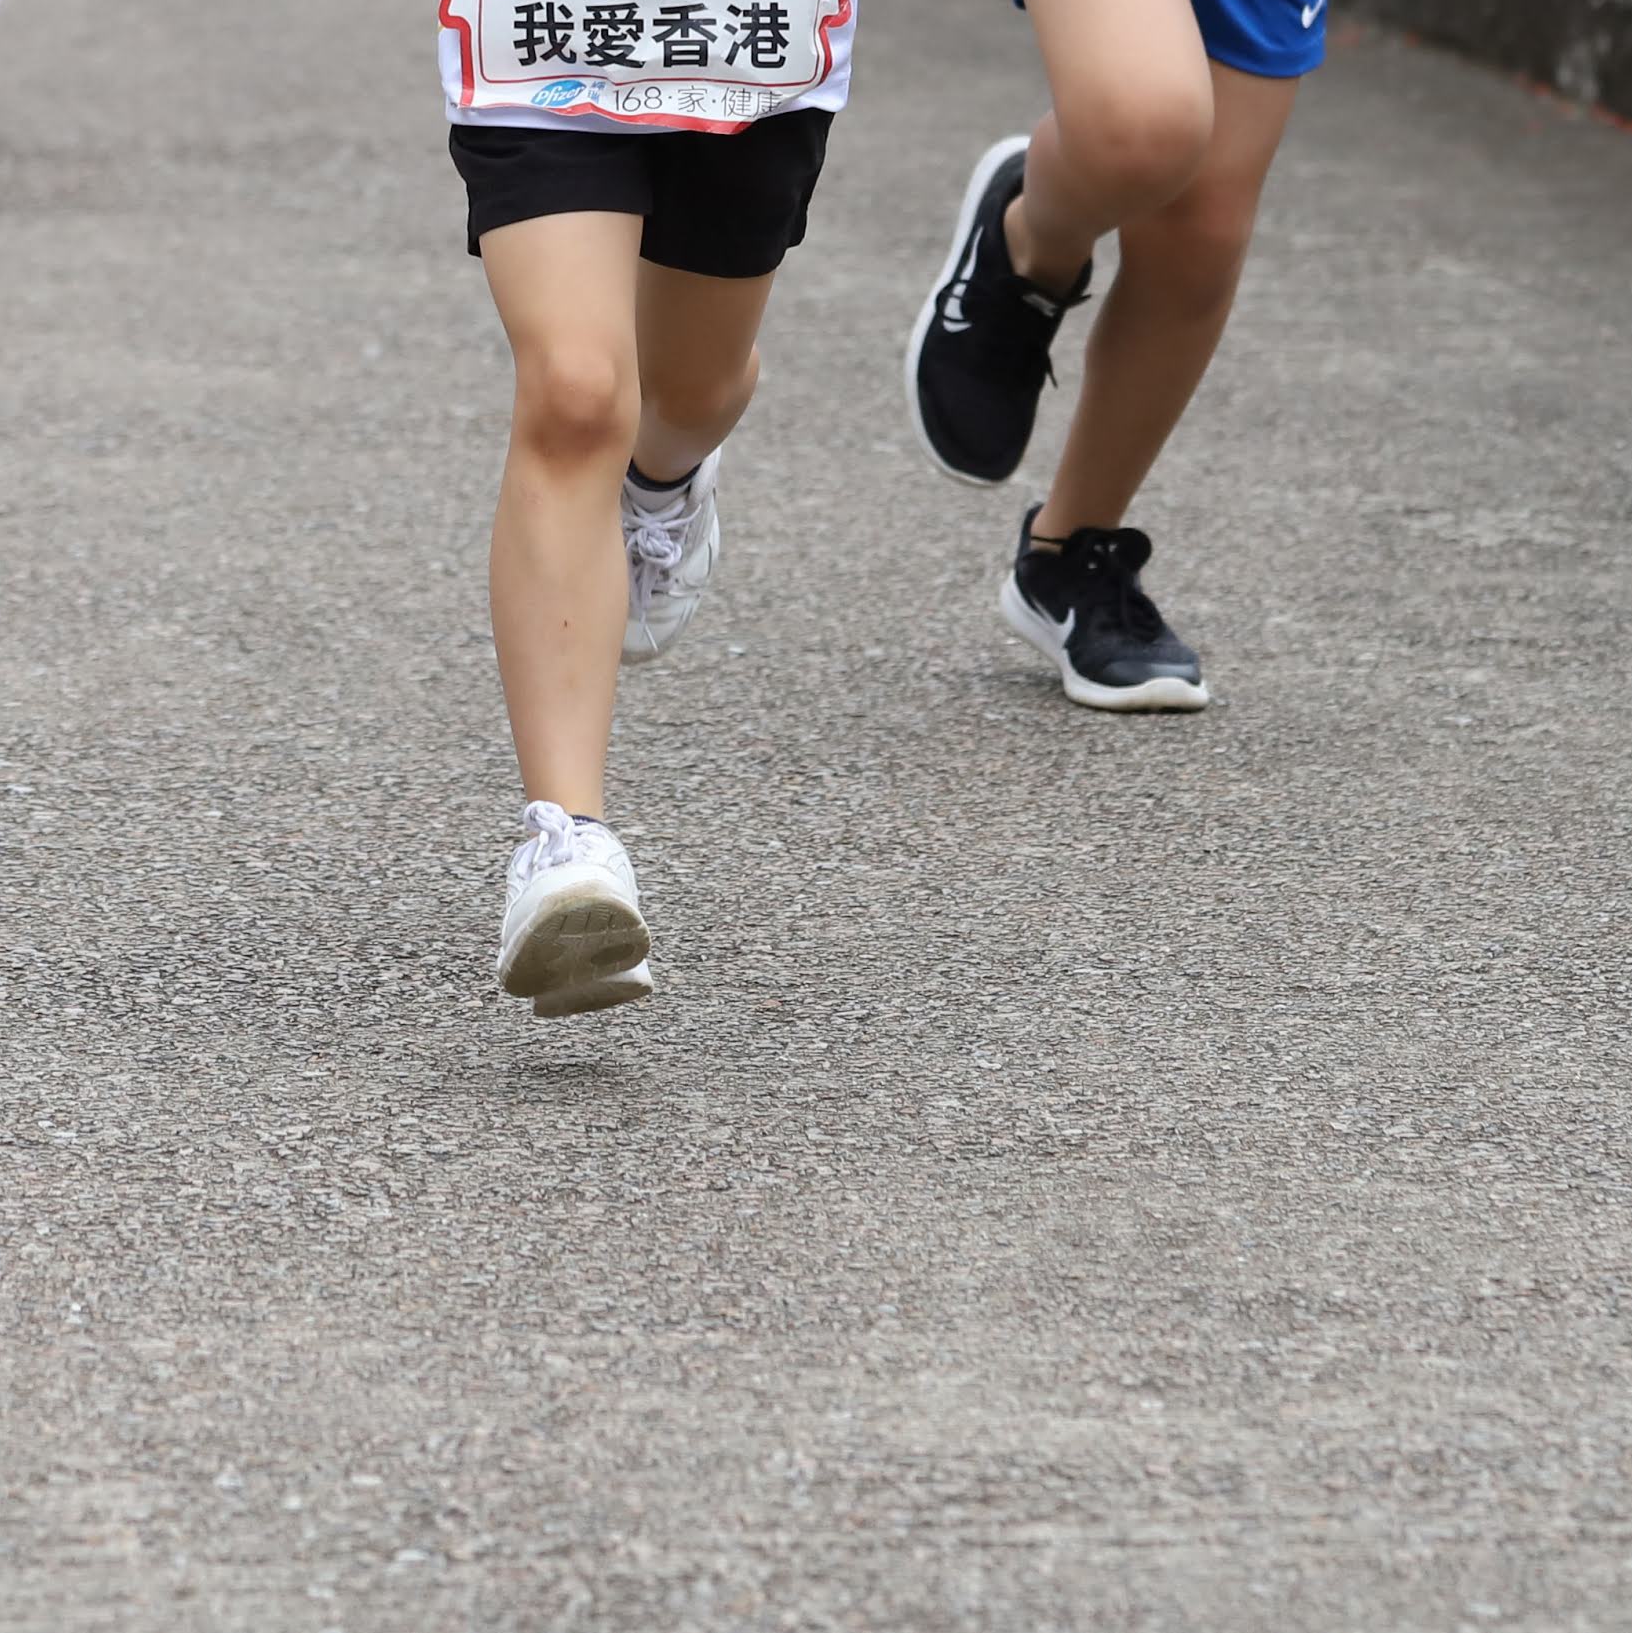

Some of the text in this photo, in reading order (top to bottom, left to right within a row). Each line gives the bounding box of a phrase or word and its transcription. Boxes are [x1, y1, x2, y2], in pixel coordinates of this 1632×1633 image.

[513, 1, 790, 69] 我愛香港
[533, 81, 584, 108] Pfizer
